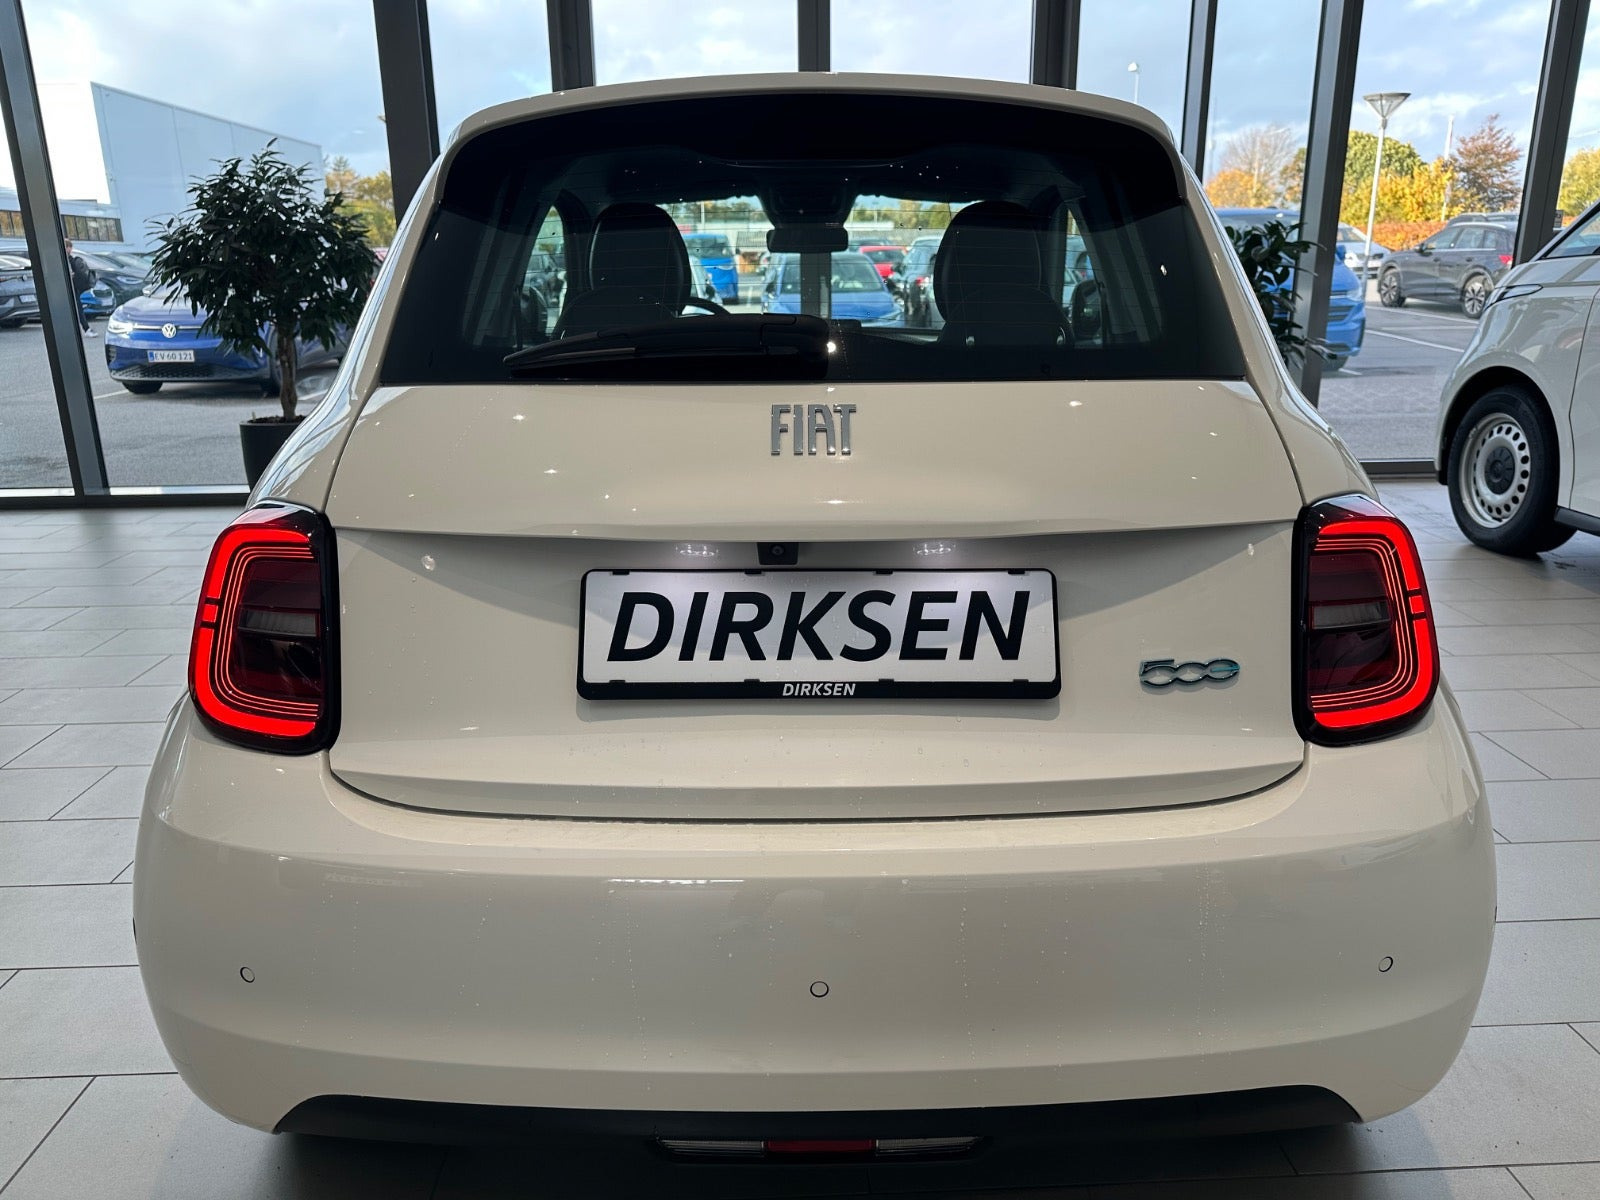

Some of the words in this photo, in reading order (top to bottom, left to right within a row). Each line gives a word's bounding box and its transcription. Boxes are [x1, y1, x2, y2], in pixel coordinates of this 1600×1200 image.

[155, 351, 165, 361] EV
[179, 351, 193, 361] 121
[771, 403, 857, 456] FIAT
[607, 590, 1031, 663] DIRKSEN
[1138, 658, 1240, 688] 500
[782, 682, 857, 697] DIRKSEN
